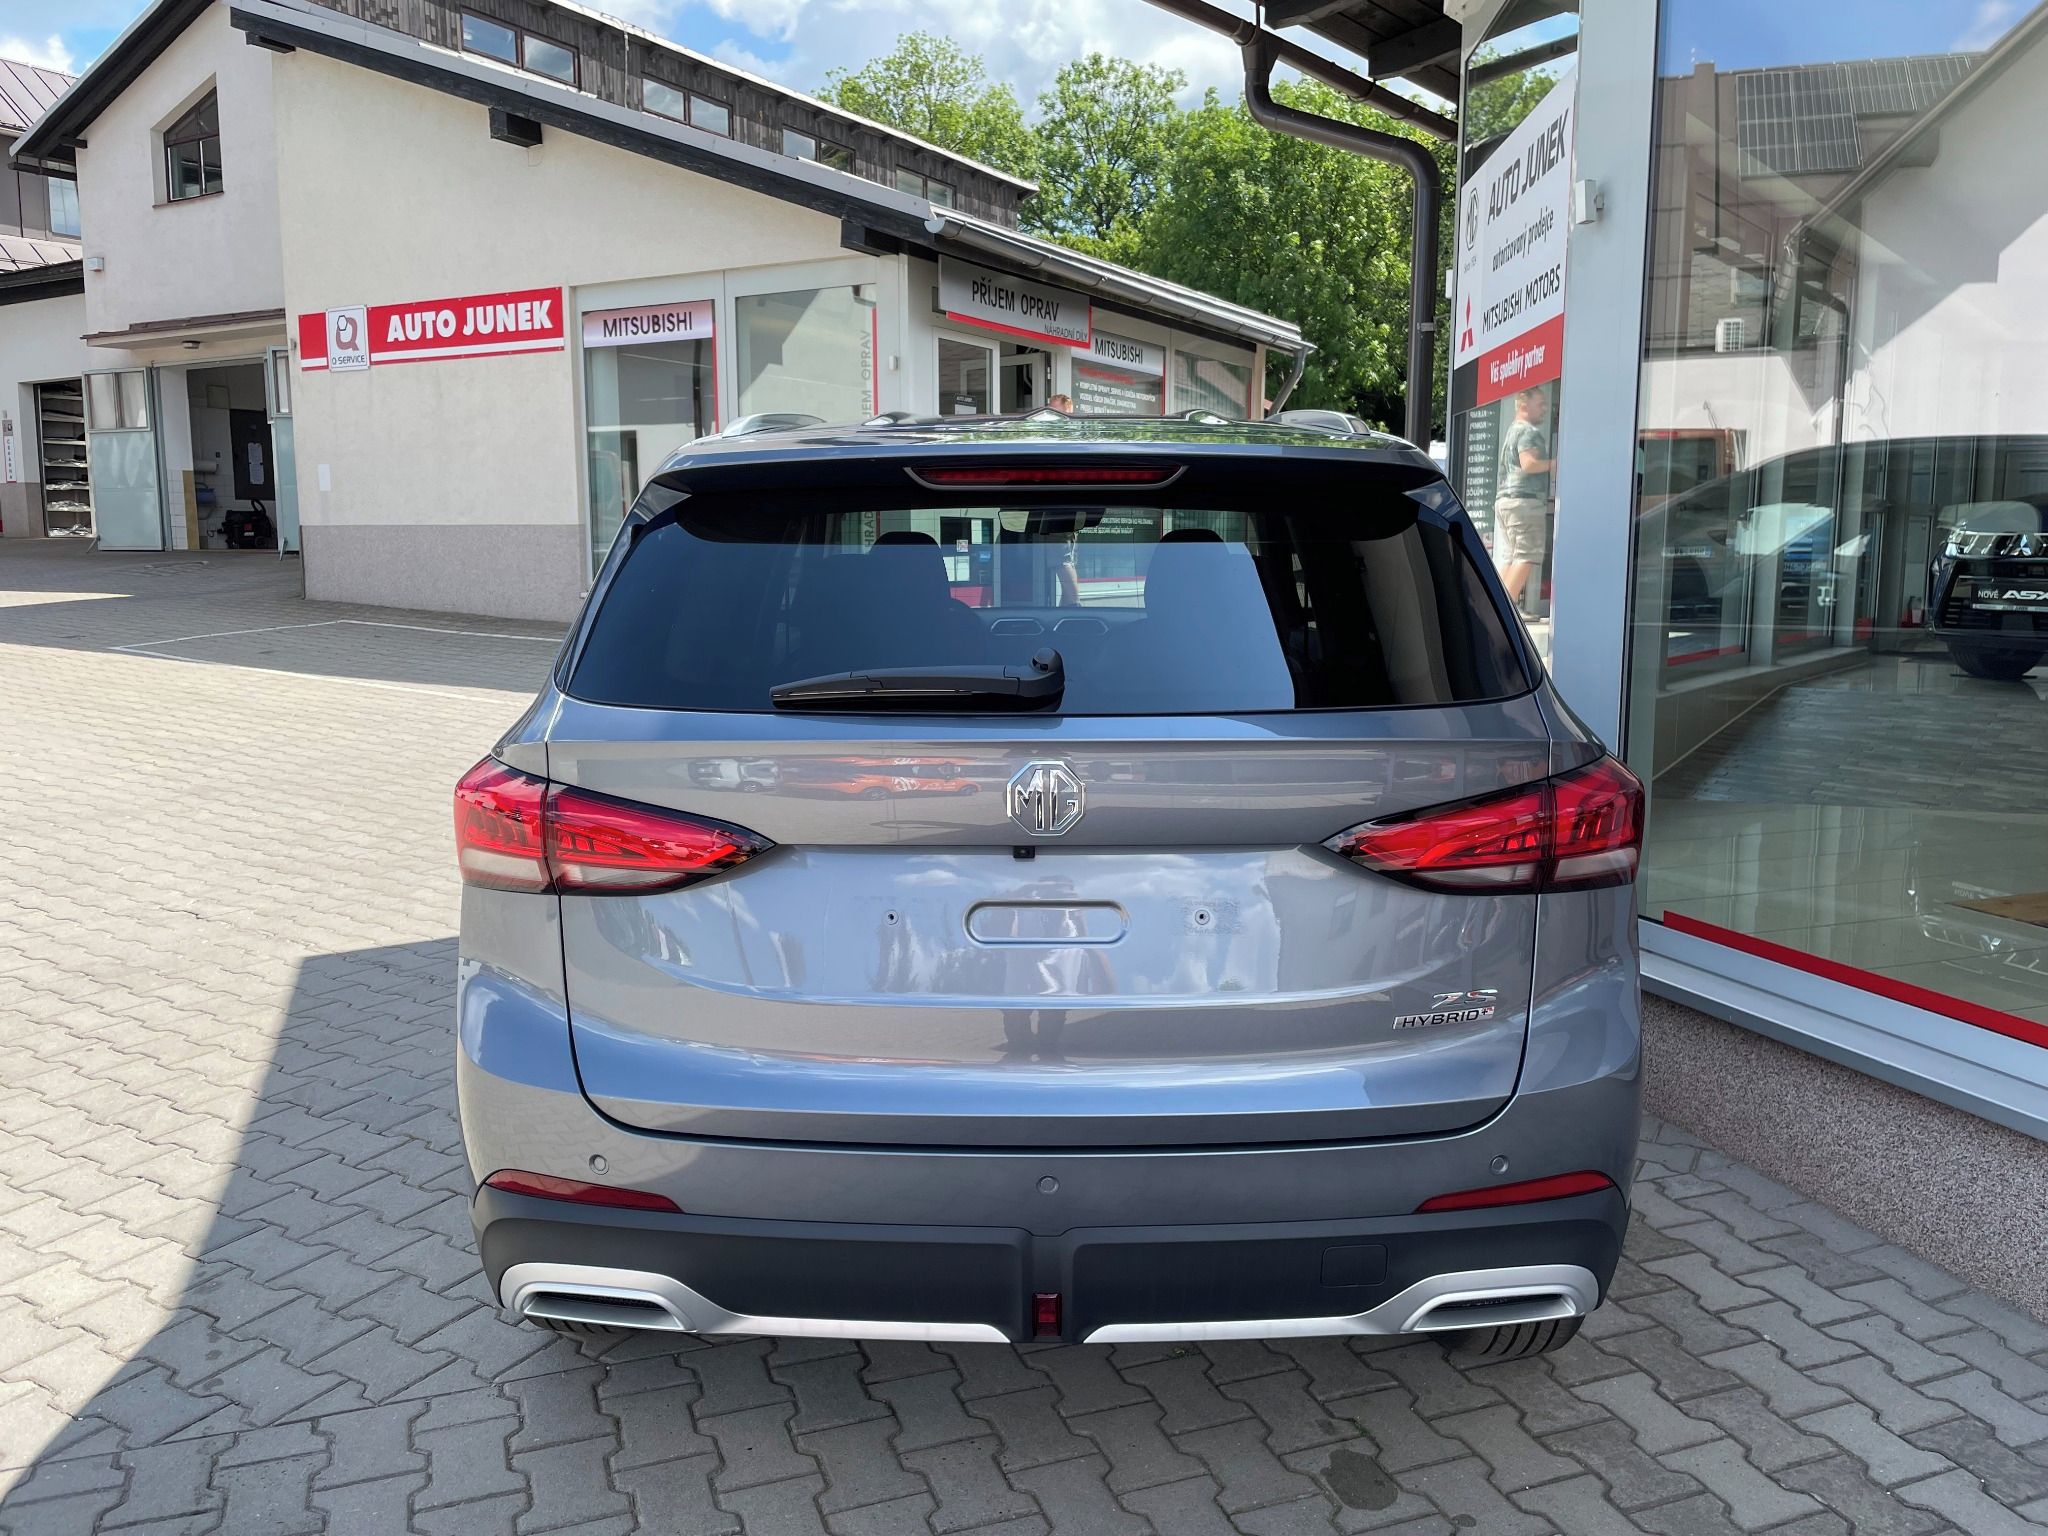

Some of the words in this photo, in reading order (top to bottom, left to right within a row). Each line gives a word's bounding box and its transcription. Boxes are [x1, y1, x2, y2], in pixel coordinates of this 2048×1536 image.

[1487, 156, 1521, 226] AUTO
[1521, 108, 1569, 190] JUNEK
[1492, 223, 1527, 272] autorizovaný
[1527, 206, 1554, 256] prodejce
[971, 277, 1015, 312] PŘÍJEM
[1020, 293, 1060, 322] OPRAV
[1481, 288, 1523, 334] MITSUBISHI
[1524, 263, 1561, 309] MOTORS
[387, 310, 457, 343] AUTO
[462, 299, 553, 337] JUNEK
[603, 312, 693, 338] MITSUBISHI
[337, 354, 366, 365] SERVICE
[860, 330, 872, 381] OPRAV
[1094, 337, 1144, 365] MITSUBISHI
[1977, 589, 1999, 600] NOVÉ
[1014, 768, 1079, 831] MG
[1431, 988, 1499, 1010] ZS
